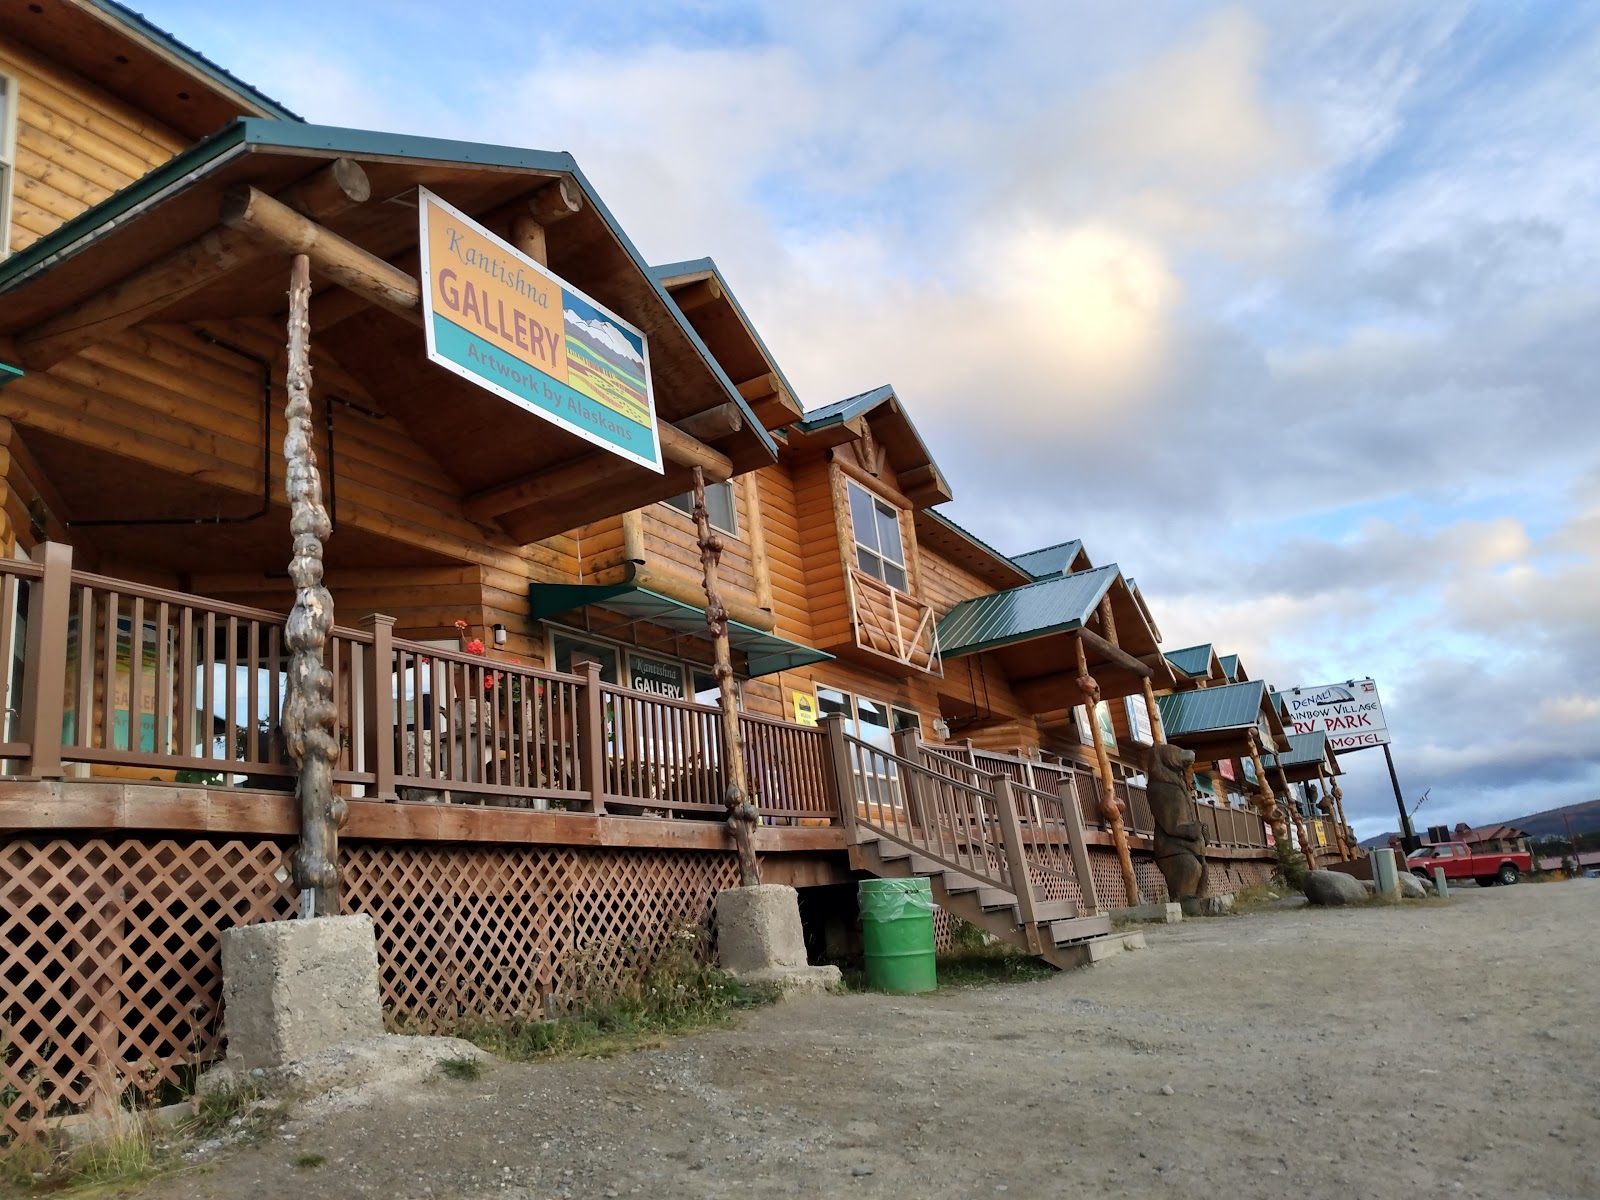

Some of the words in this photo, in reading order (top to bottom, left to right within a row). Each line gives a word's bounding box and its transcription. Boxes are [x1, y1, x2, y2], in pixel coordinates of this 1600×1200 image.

[446, 227, 548, 309] Kantishna
[438, 268, 560, 368] GALLERY
[467, 342, 538, 394] Artwork
[543, 382, 562, 408] by
[567, 396, 633, 441] Alaskans
[635, 658, 677, 680] Kantishna
[634, 676, 680, 700] GALLERY
[1292, 689, 1332, 711] DENALI
[1289, 708, 1330, 721] AINBOW
[1333, 702, 1378, 715] VILLAGE
[1293, 719, 1316, 734] RV
[1324, 713, 1372, 731] PARK
[1330, 733, 1384, 749] MOTEL
